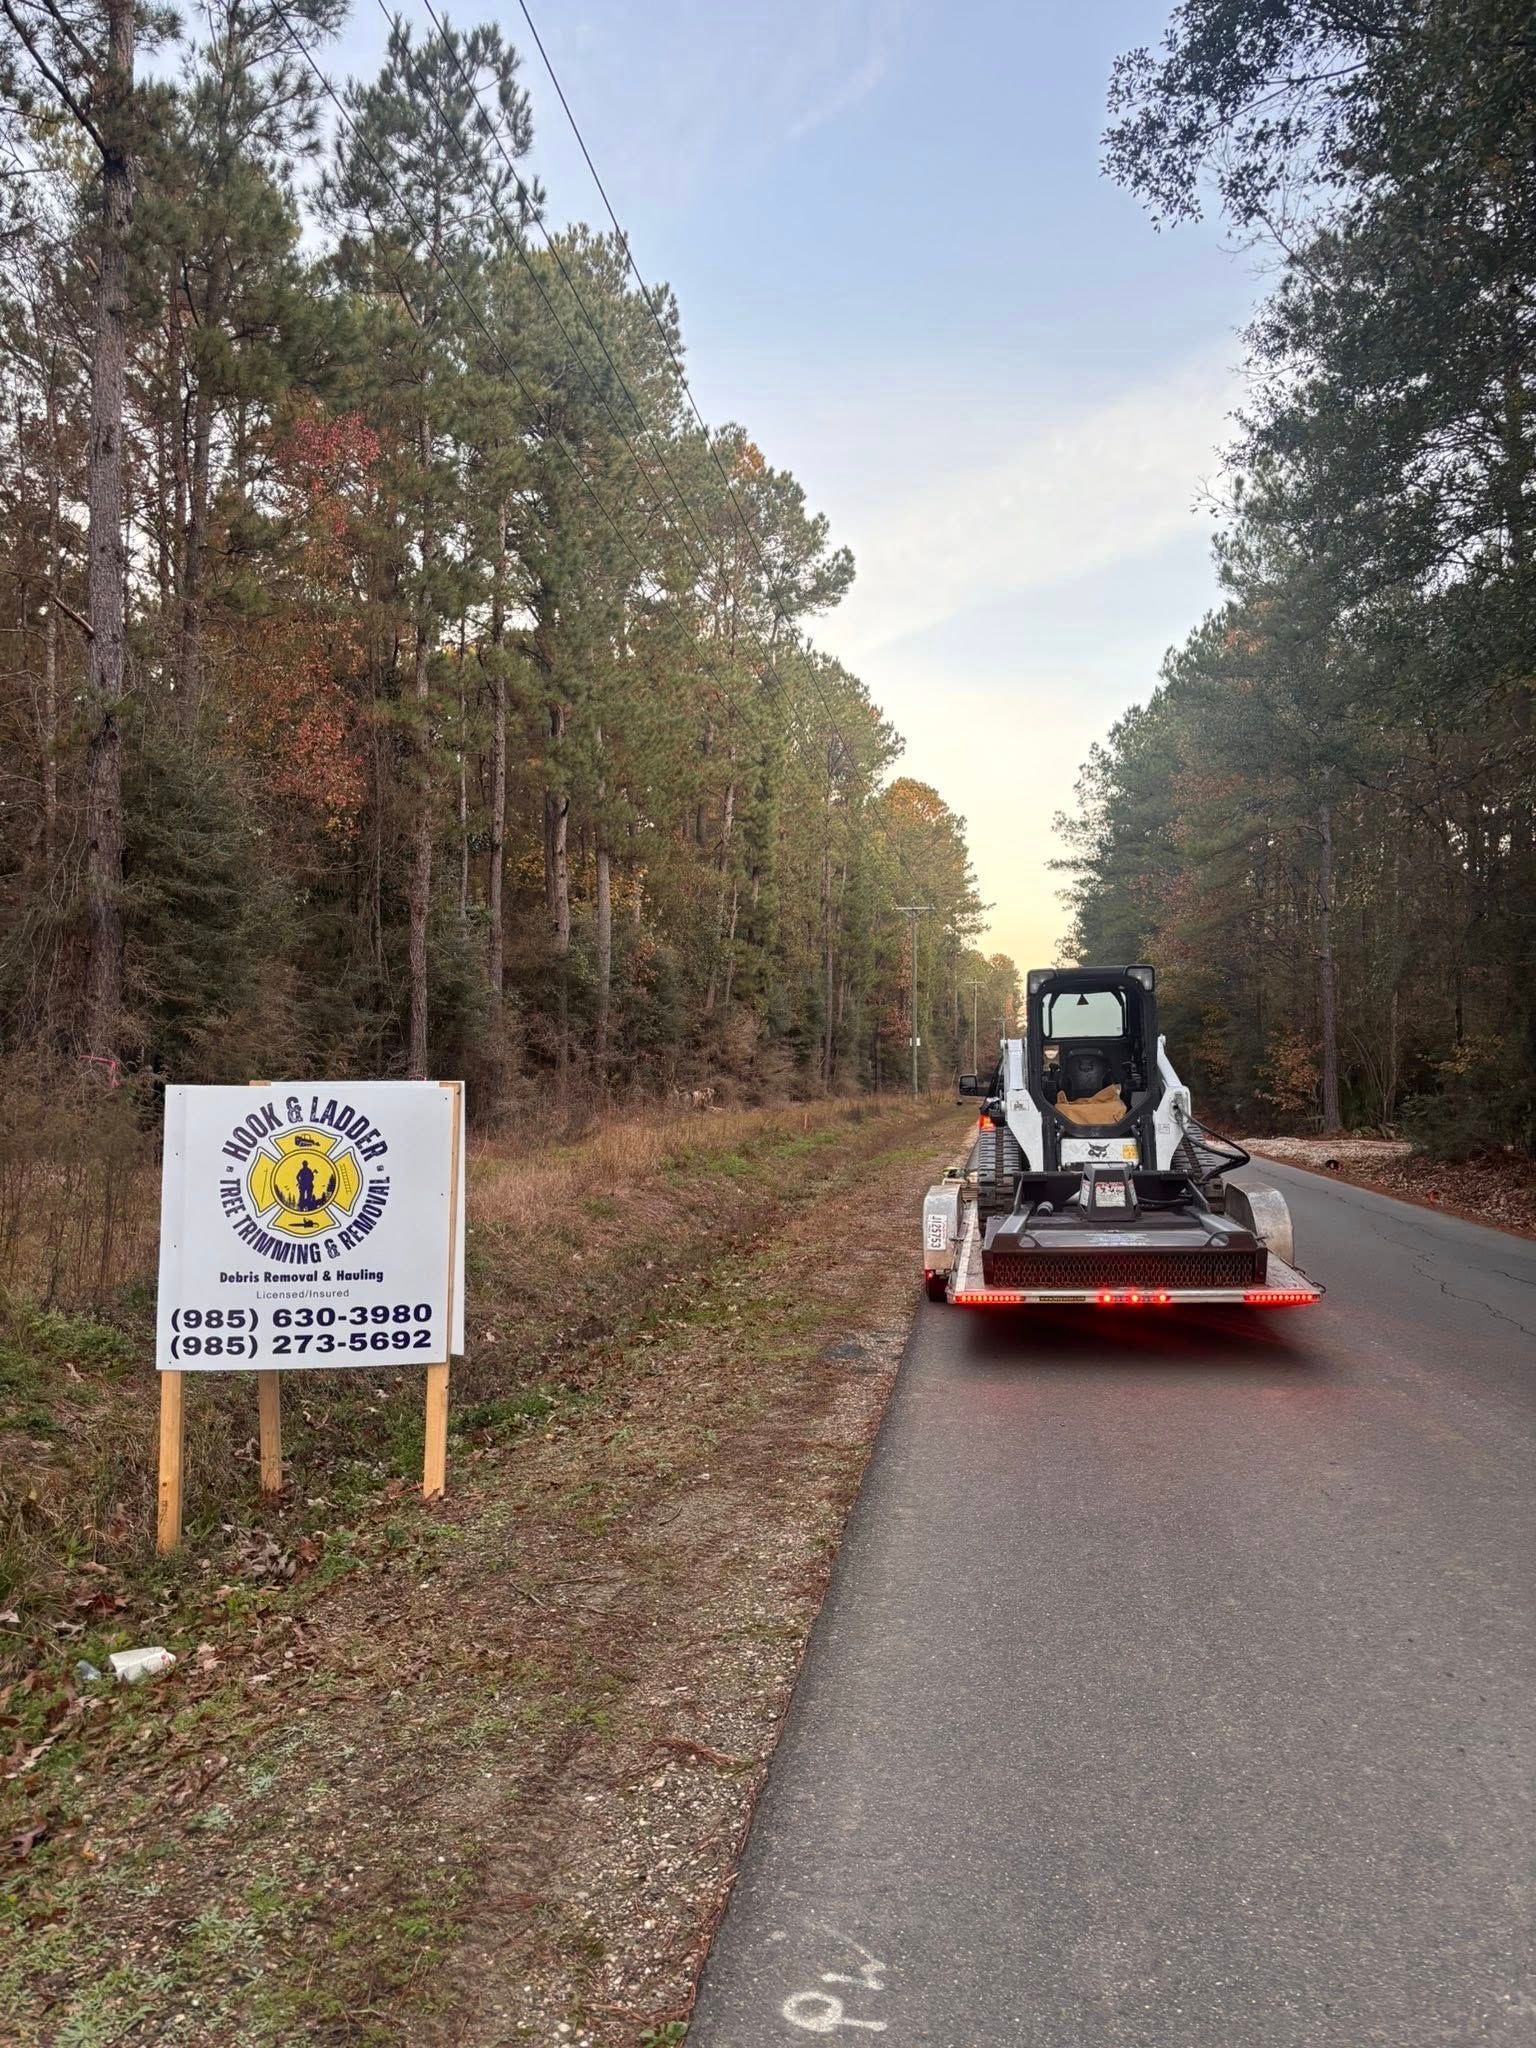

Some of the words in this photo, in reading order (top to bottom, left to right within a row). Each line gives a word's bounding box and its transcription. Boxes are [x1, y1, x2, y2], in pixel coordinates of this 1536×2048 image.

[222, 1102, 283, 1162] HOOK
[286, 1096, 303, 1123] &
[310, 1096, 388, 1162] LADDER
[220, 1178, 246, 1217] TREE
[341, 1176, 390, 1251] REMOVAL
[232, 1213, 321, 1264] TRIMMING
[325, 1238, 340, 1259] &
[220, 1271, 259, 1283] Debris
[264, 1271, 317, 1282] Removal
[322, 1271, 331, 1281] &
[337, 1270, 384, 1282] Hauling
[256, 1289, 350, 1299] Licensed/Insured
[171, 1308, 259, 1332] (985)
[272, 1303, 432, 1328] 630-3980
[171, 1335, 258, 1358] (985)
[272, 1330, 431, 1354] 273-5692
